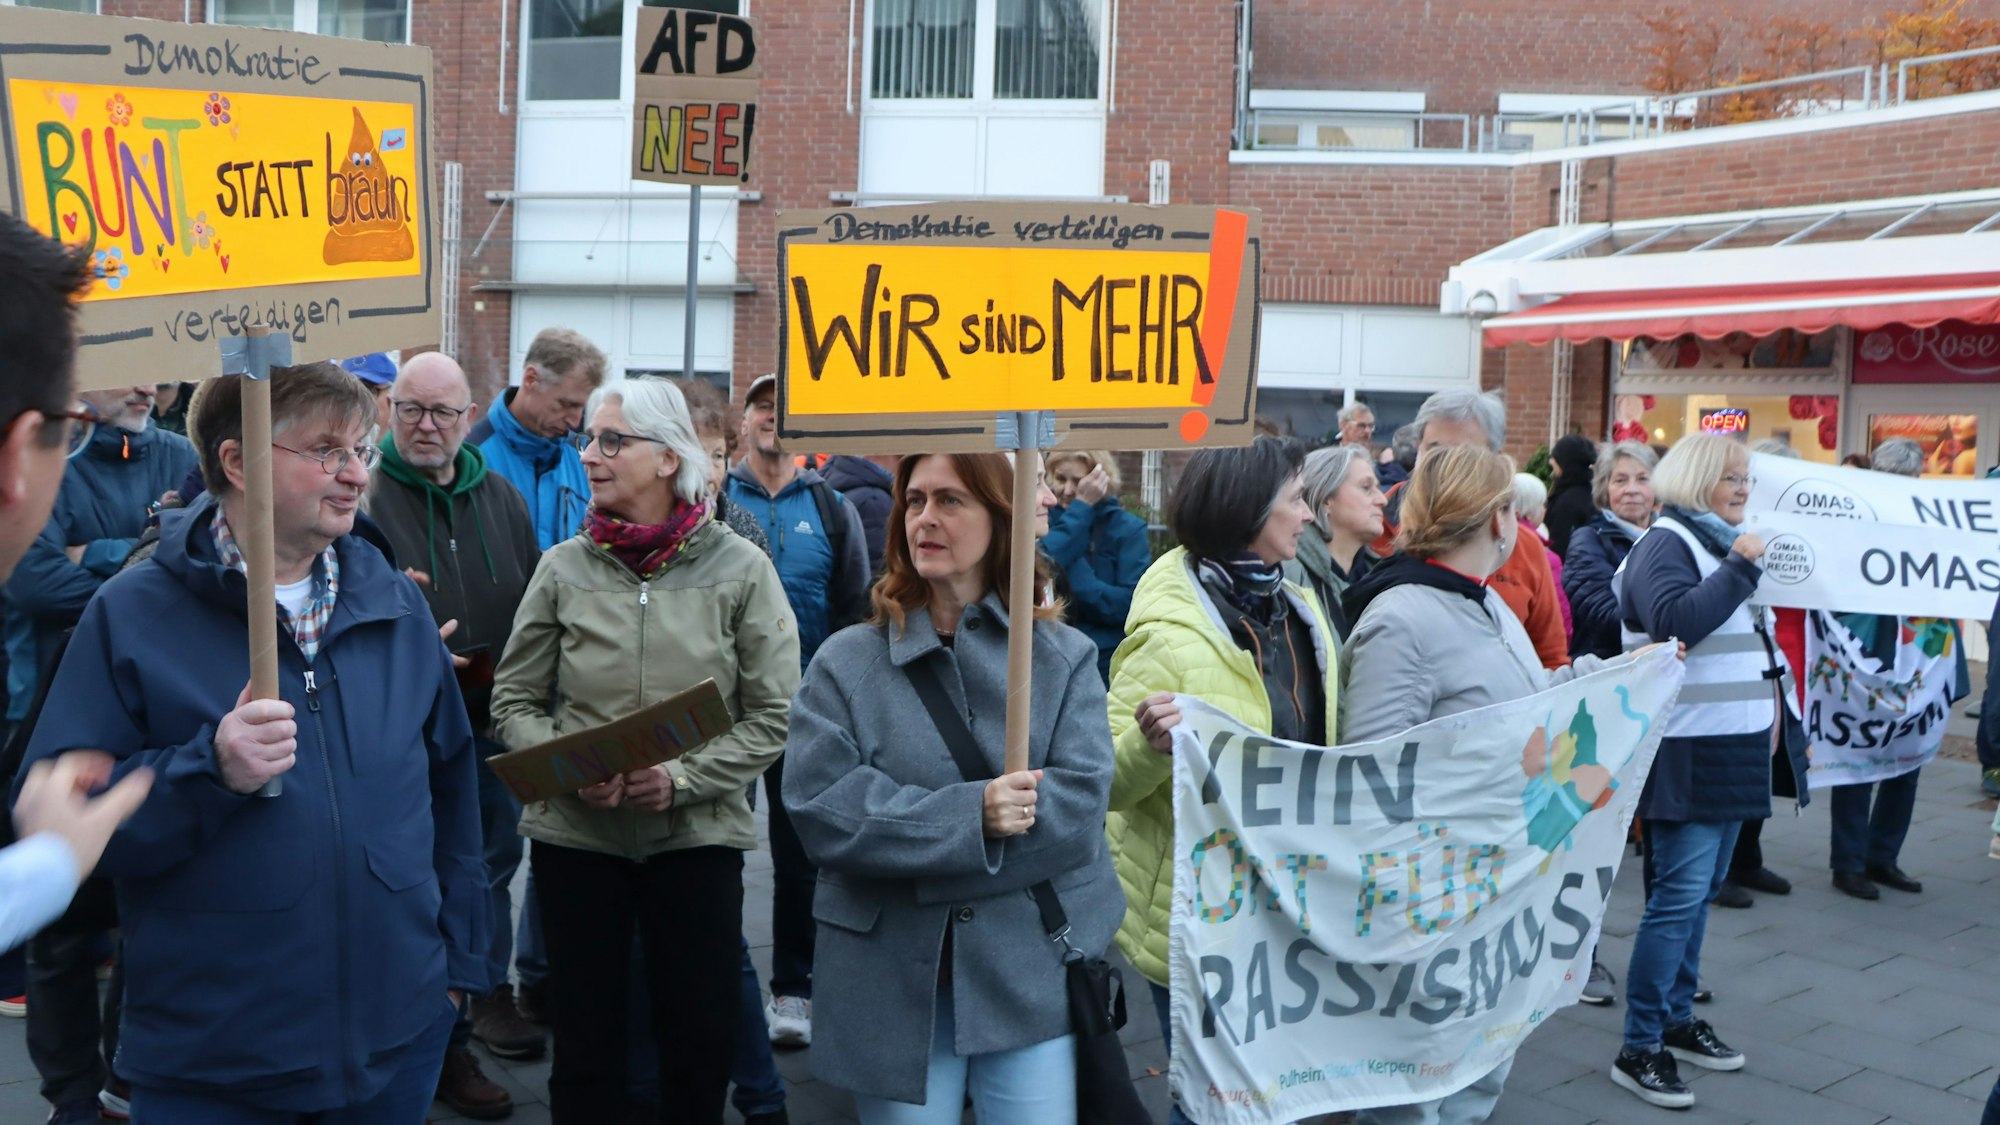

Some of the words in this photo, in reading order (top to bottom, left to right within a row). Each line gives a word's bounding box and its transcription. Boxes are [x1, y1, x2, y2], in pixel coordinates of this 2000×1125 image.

[640, 9, 756, 74] AFD
[640, 103, 756, 182] NEE!
[37, 117, 201, 257] BUNT
[216, 160, 313, 219] STATT
[326, 131, 411, 227] braun
[1015, 213, 1163, 249] verteidigen
[166, 297, 341, 342] verteidigen
[1701, 413, 1747, 431] OPEN
[1796, 491, 1856, 511] OMAS
[1911, 495, 1998, 534] NIE
[1769, 551, 1808, 563] GEGEN
[1773, 541, 1805, 552] OMAS
[1766, 561, 1811, 574] RECHTS
[1860, 547, 2000, 592] OMAS
[1355, 820, 1506, 937] FÜR
[1367, 1059, 1416, 1077] Kerpen
